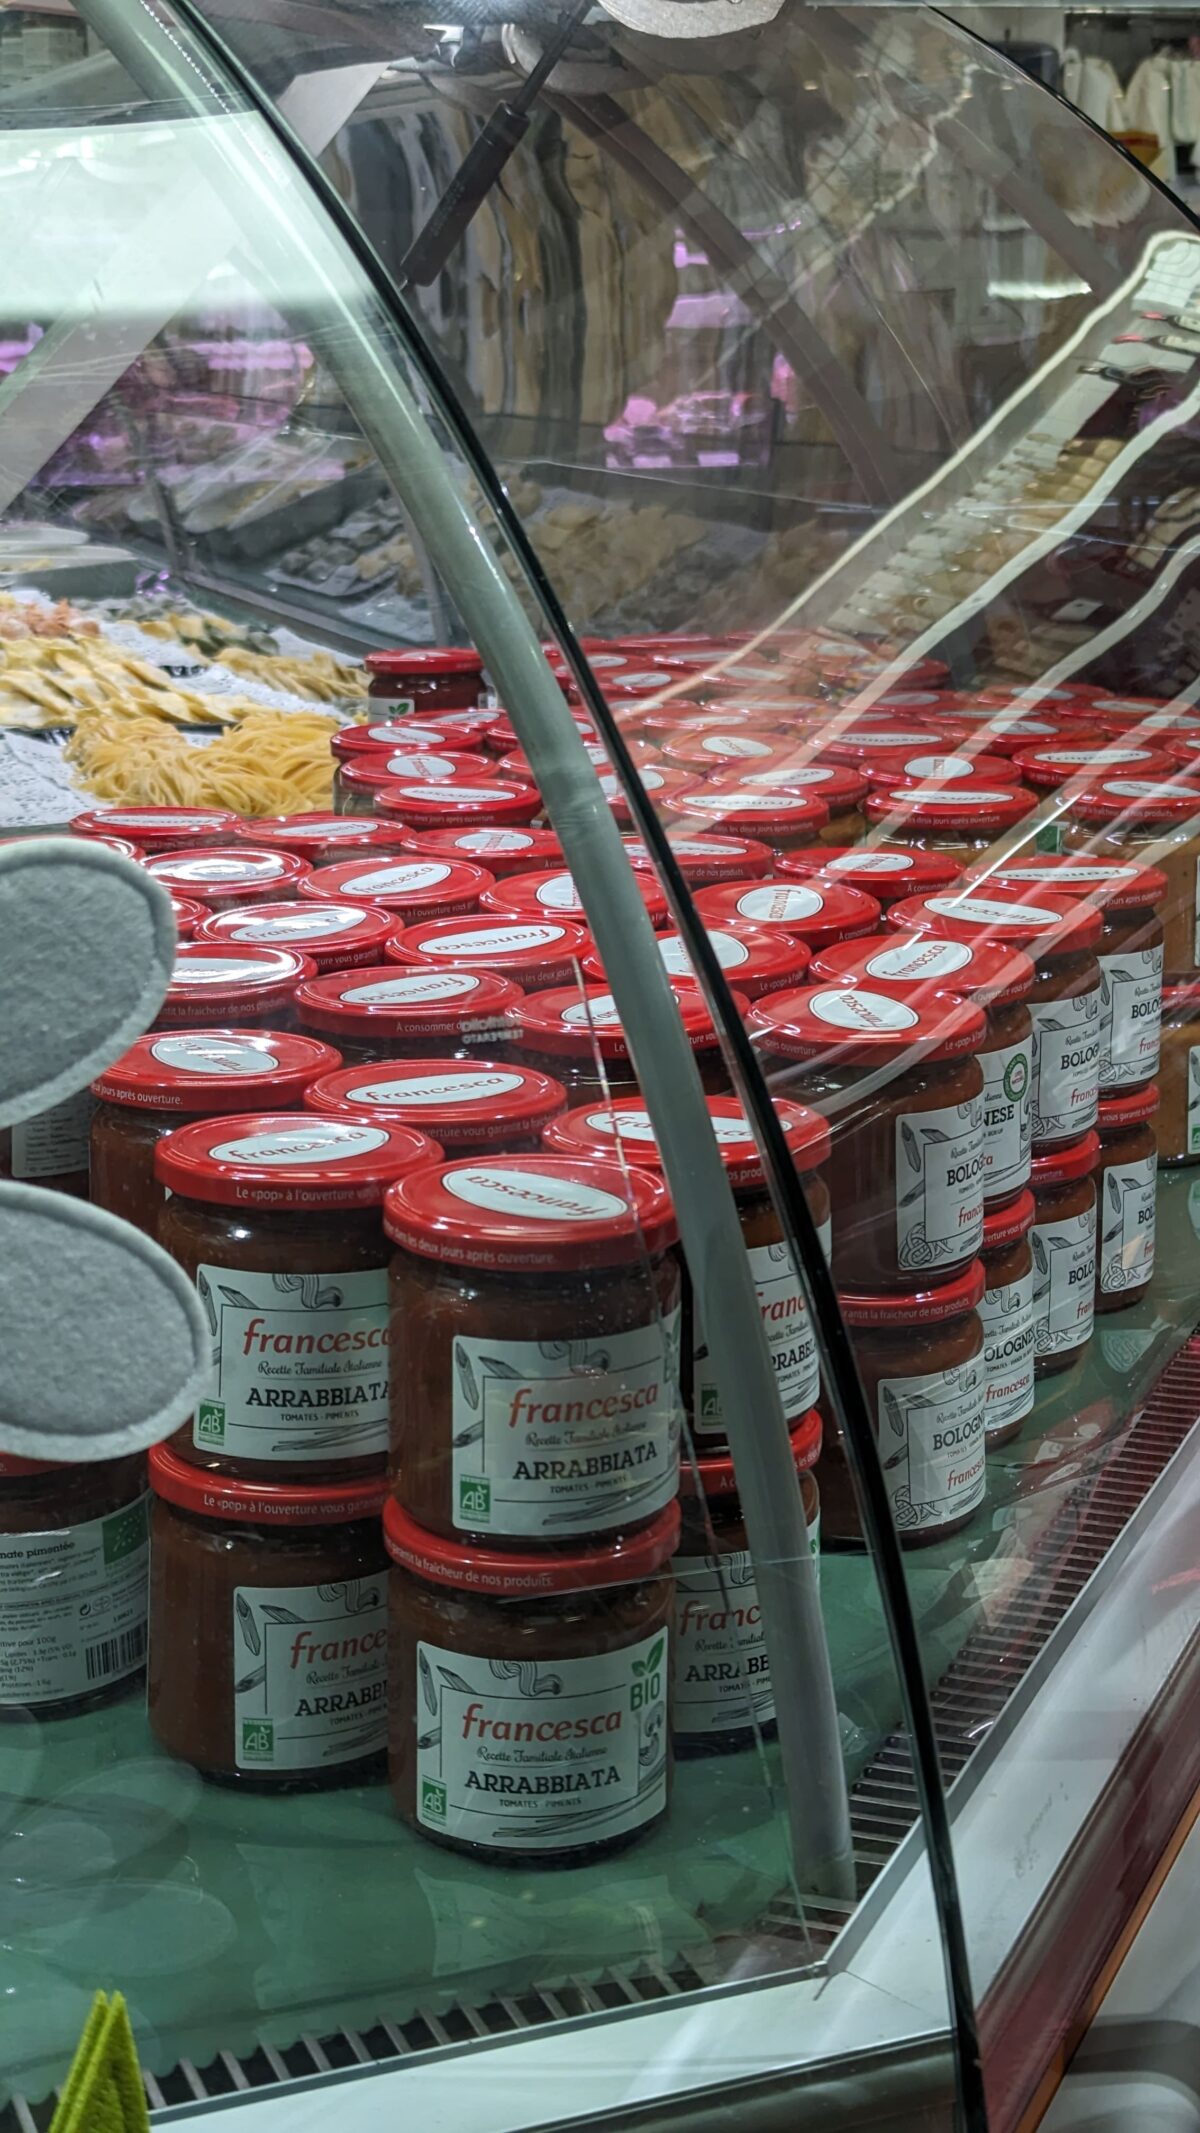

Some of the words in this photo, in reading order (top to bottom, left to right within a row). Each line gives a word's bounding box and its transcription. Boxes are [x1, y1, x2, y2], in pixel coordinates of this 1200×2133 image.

[614, 1042, 625, 1053] Le
[365, 1076, 505, 1102] francesca
[463, 1126, 486, 1137] vous
[236, 1186, 249, 1199] Le
[251, 1187, 284, 1203] «pop»
[286, 1188, 294, 1201] à
[295, 1187, 355, 1202] l'ouverture
[466, 1174, 609, 1217] francesca
[440, 1241, 465, 1260] jours
[466, 1249, 495, 1266] après
[258, 1360, 292, 1376] Recette
[294, 1360, 342, 1376] Familiale
[509, 1382, 659, 1428] francesca
[281, 1412, 319, 1423] TOMATES
[325, 1409, 360, 1421] PIMENTS
[512, 1441, 659, 1480] ARRABBIATA
[549, 1482, 589, 1496] TOMATES
[203, 1493, 215, 1507] Le
[217, 1497, 247, 1513] «pop»
[249, 1501, 256, 1513] à
[257, 1500, 318, 1516] l'ouverture
[320, 1502, 346, 1514] vous
[461, 1492, 485, 1512] AB
[465, 1569, 481, 1584] de
[480, 1571, 502, 1586] nos
[629, 1672, 661, 1713] BIO
[462, 1702, 624, 1742] francesca
[243, 1731, 272, 1751] AB
[476, 1746, 513, 1764] Recette
[514, 1748, 564, 1765] Familiale
[464, 1764, 622, 1797] ARRABBIATA
[422, 1795, 443, 1814] AB
[499, 1798, 539, 1810] TOMATES
